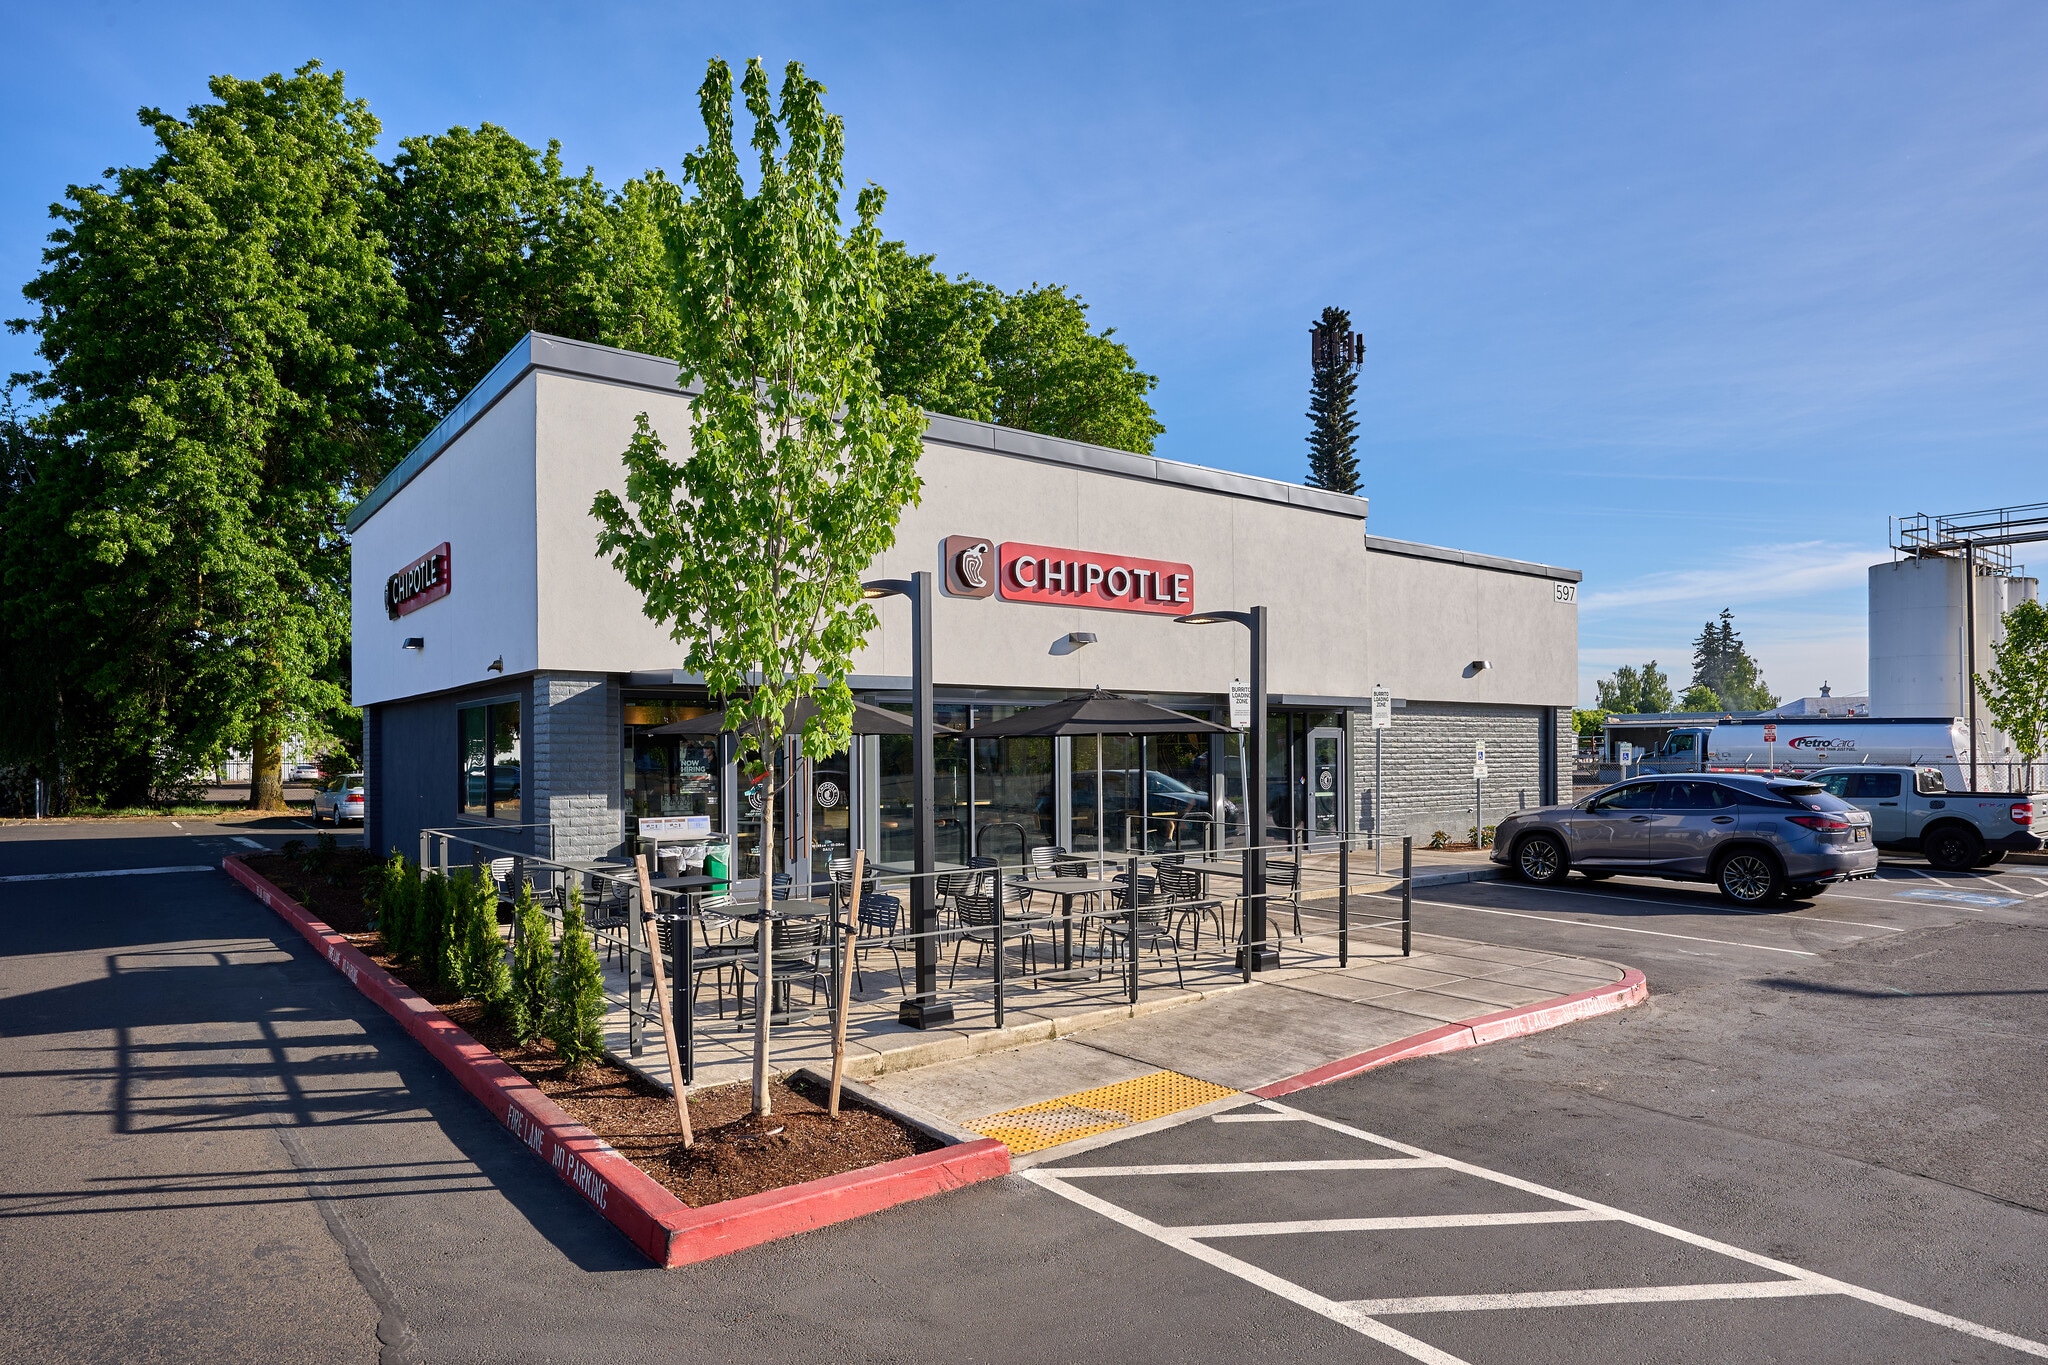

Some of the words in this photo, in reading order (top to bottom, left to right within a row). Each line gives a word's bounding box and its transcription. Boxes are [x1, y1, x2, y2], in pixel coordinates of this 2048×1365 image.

[393, 554, 437, 604] CHIPOTLE
[1014, 555, 1190, 603] CHIPOTLE
[1556, 584, 1576, 602] 597
[1502, 1016, 1527, 1036] FIRE
[1526, 1009, 1552, 1031] LANE
[506, 1103, 524, 1138] FIRE
[523, 1117, 545, 1155] LANE
[551, 1143, 566, 1171] NO
[566, 1152, 609, 1210] PARKING
